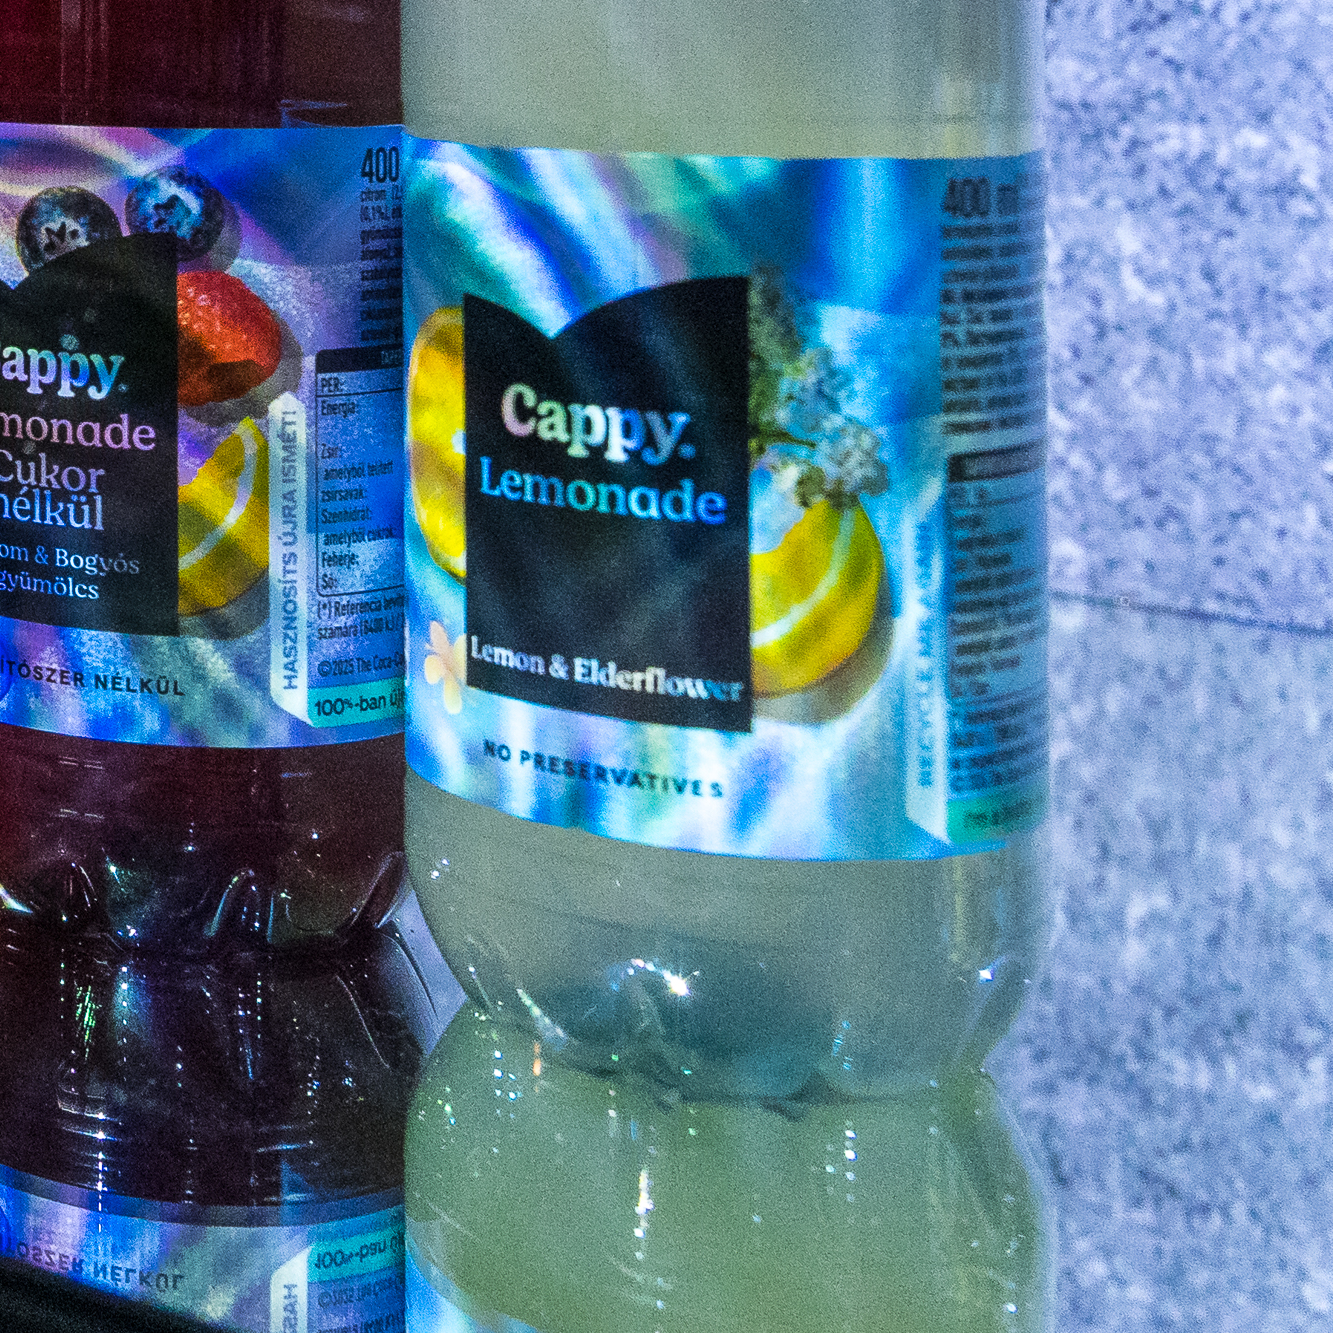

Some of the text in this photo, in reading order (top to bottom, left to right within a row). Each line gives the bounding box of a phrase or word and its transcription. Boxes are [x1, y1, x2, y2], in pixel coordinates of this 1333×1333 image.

[360, 146, 400, 184] 400
[480, 455, 728, 525] Lemonade
[34, 545, 49, 565] &
[55, 547, 140, 577] Bogyós
[277, 411, 298, 690] HASZNOSÍTS ÚJRA ISMÉT!
[94, 672, 185, 697] NÉLKÜL
[471, 634, 743, 702] Lemon & Elderflower
[484, 738, 724, 798] NO PRESERVATIVES
